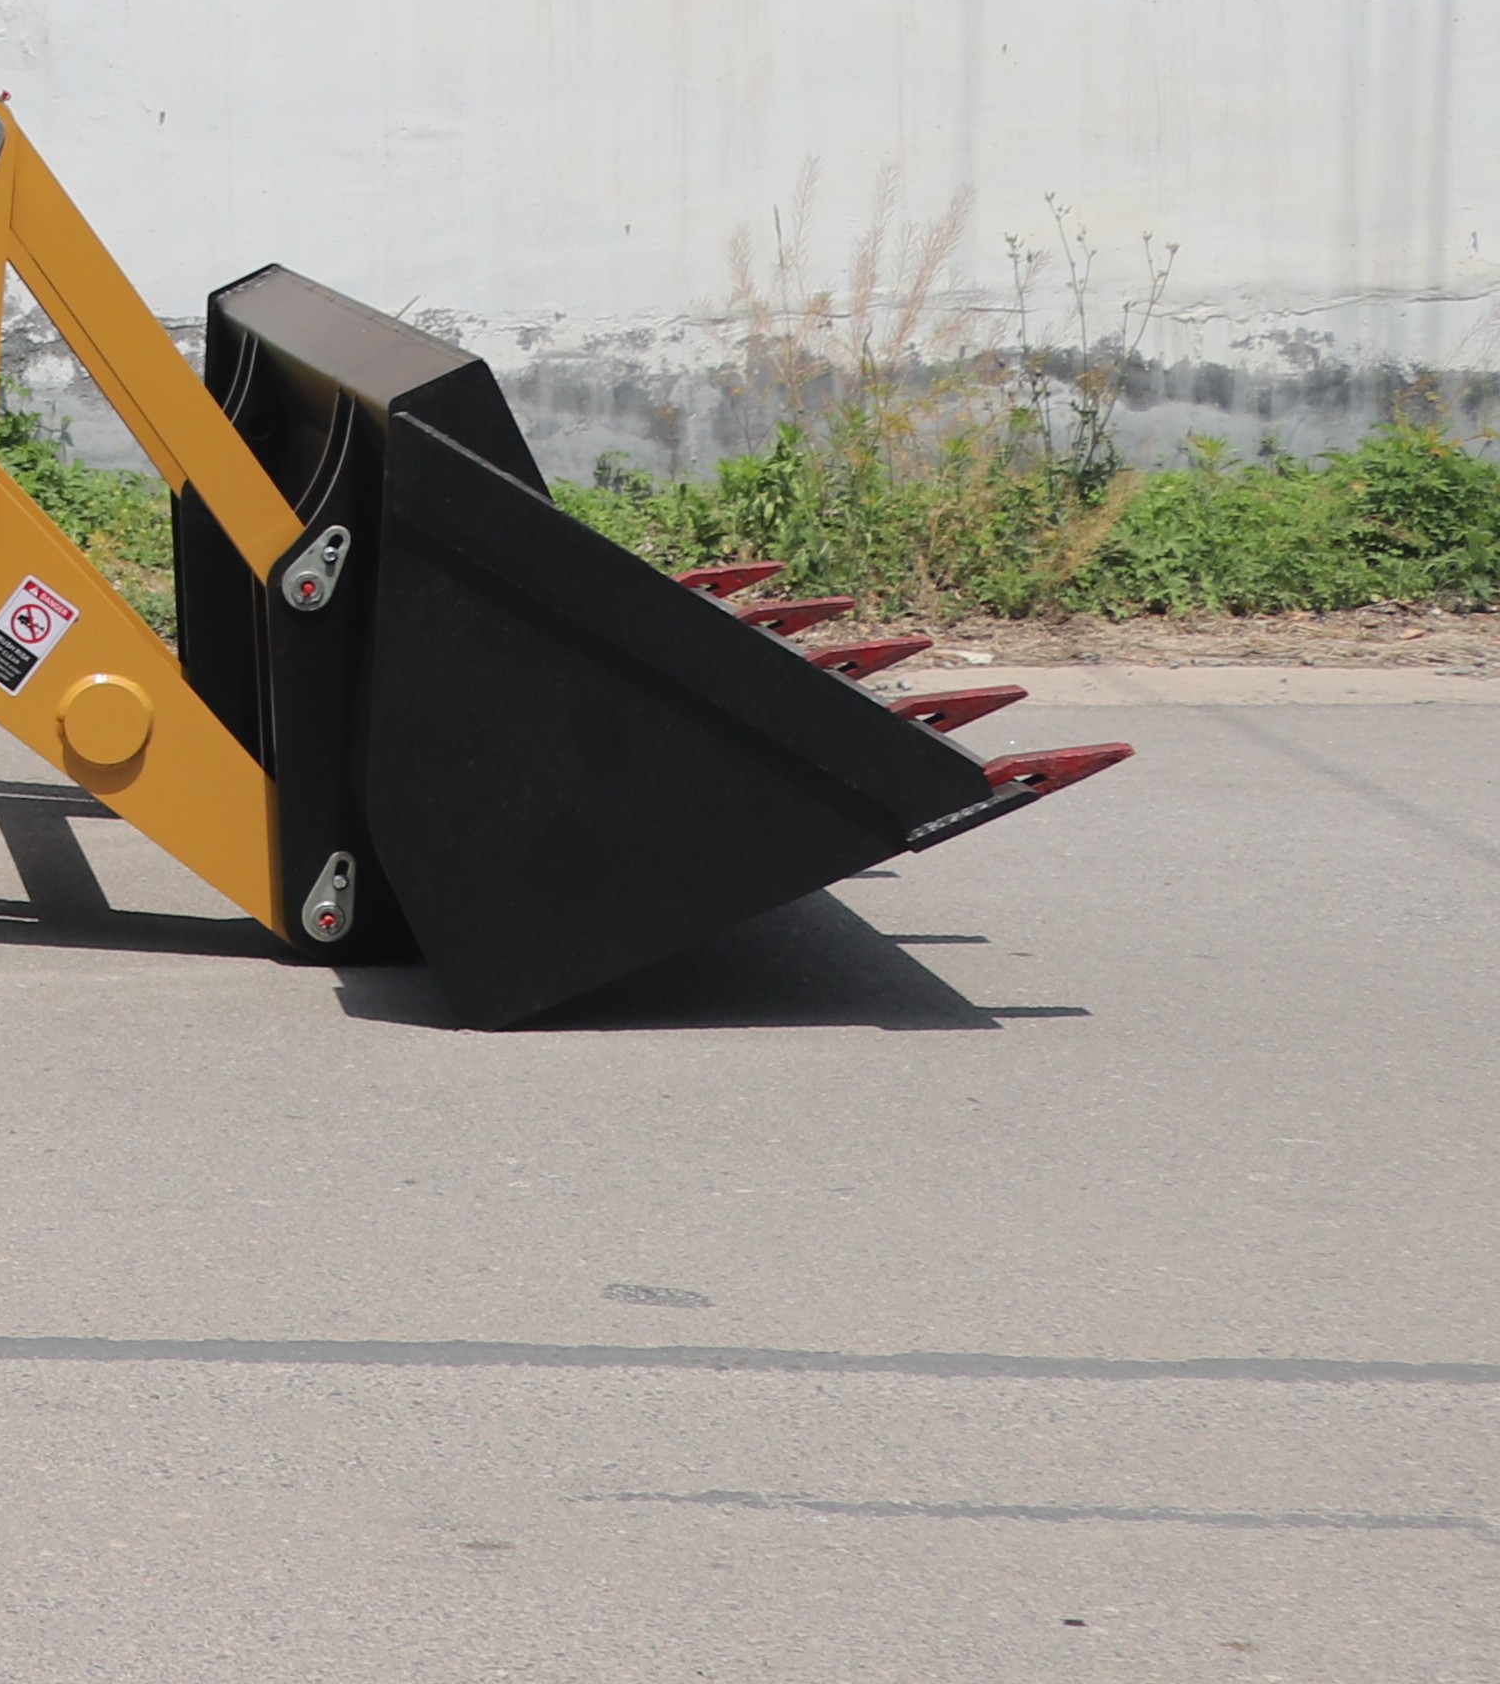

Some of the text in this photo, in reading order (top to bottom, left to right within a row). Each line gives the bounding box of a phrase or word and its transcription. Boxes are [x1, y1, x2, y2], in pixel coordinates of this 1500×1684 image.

[39, 593, 69, 617] DANGER
[0, 649, 20, 665] CLEAR
[13, 646, 31, 662] RISK
